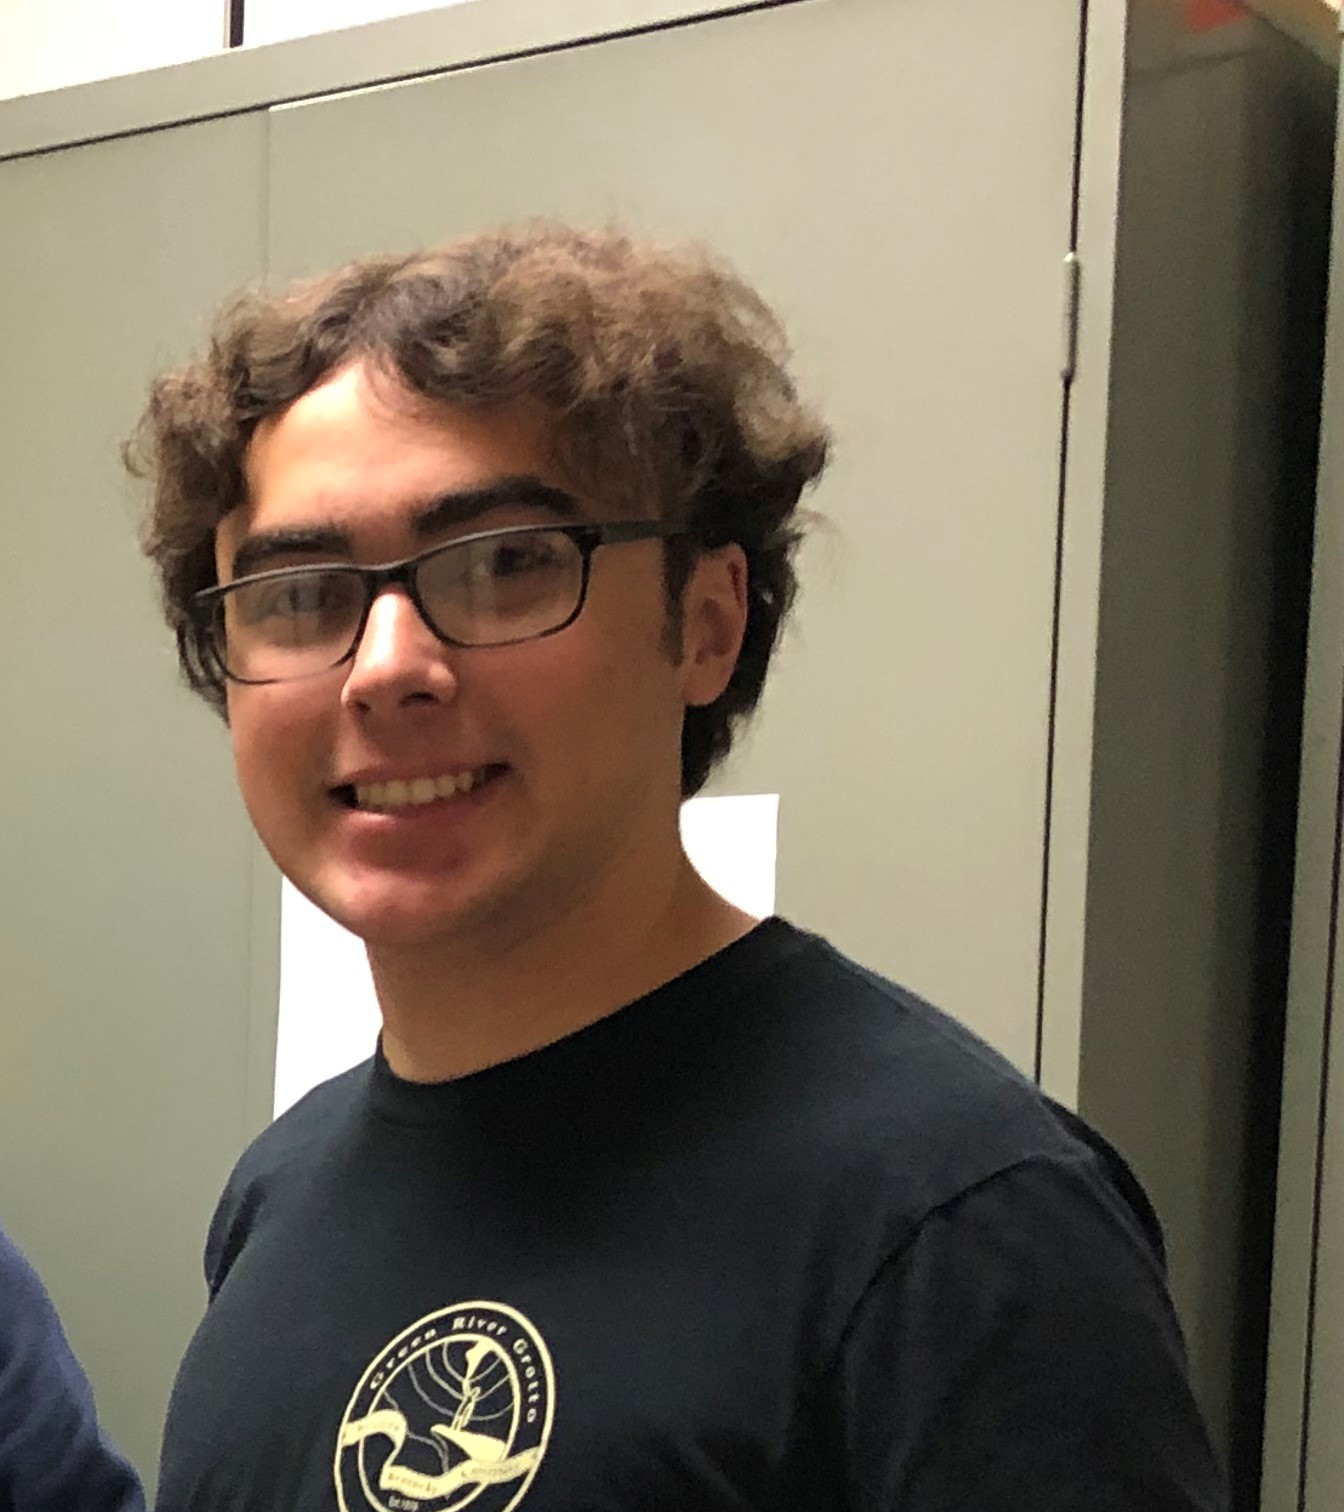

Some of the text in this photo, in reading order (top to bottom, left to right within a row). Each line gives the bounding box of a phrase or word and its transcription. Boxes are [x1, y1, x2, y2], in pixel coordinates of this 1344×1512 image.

[369, 1315, 538, 1424] Green River Grotto
